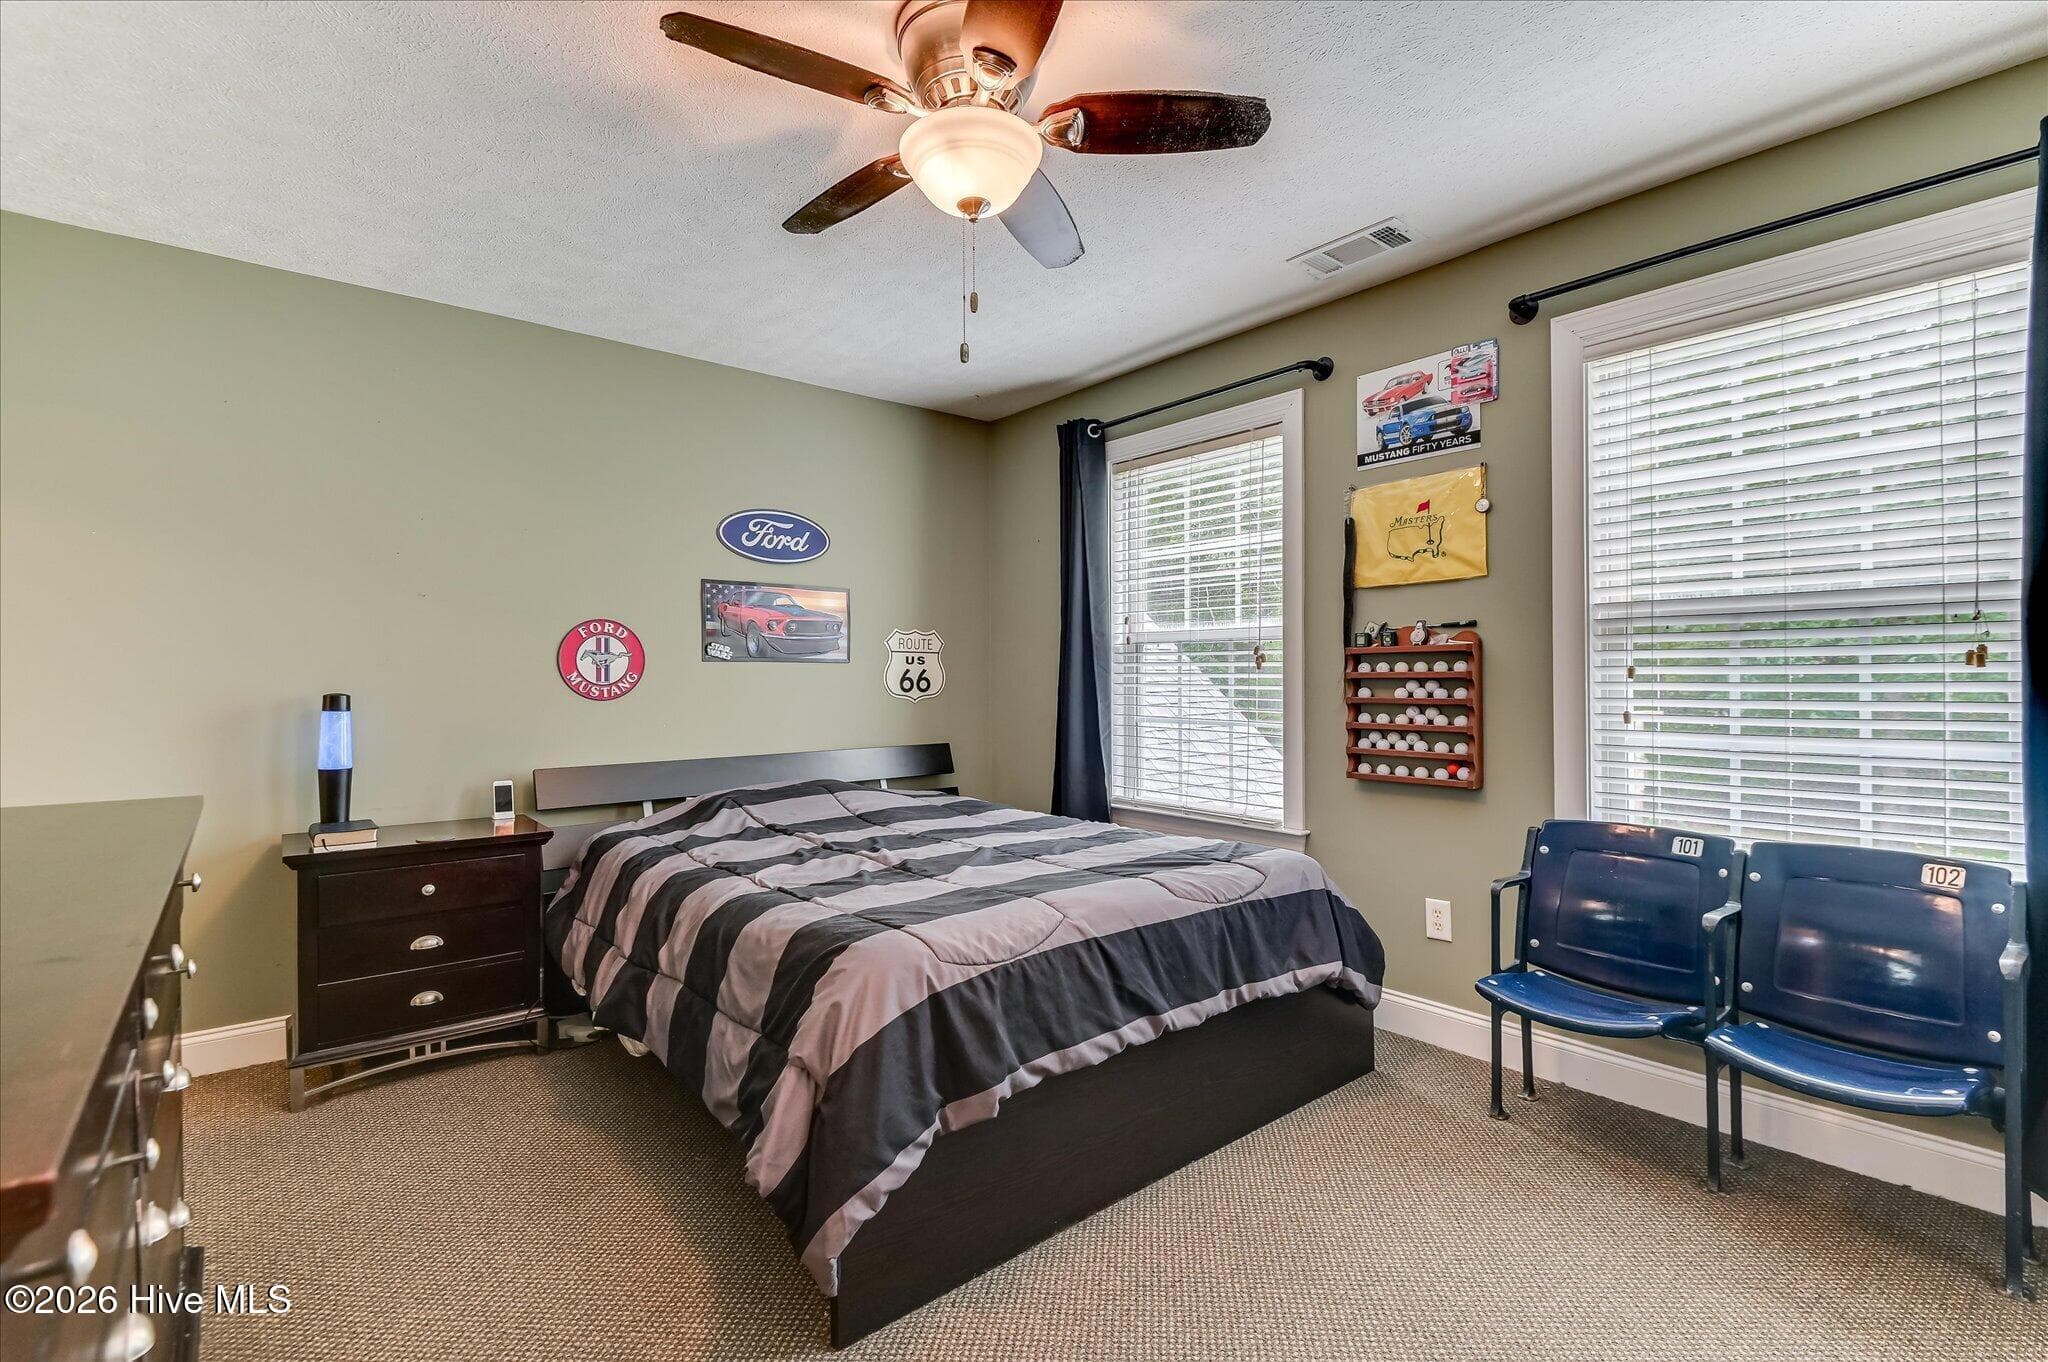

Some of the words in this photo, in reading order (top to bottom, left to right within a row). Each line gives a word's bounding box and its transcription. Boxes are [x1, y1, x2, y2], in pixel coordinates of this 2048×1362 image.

[1364, 447, 1410, 464] MUSTANG
[1412, 441, 1438, 453] FIFTY
[1439, 434, 1472, 449] YEARS
[741, 518, 811, 552] Ford
[578, 622, 628, 639] FORD
[707, 642, 731, 652] STAR
[898, 637, 933, 651] ROUTE
[707, 649, 733, 660] WARS
[905, 655, 926, 666] US
[566, 671, 638, 698] MUSTANG
[899, 668, 931, 693] 66
[1676, 838, 1699, 855] 101
[1926, 866, 1962, 887] 102
